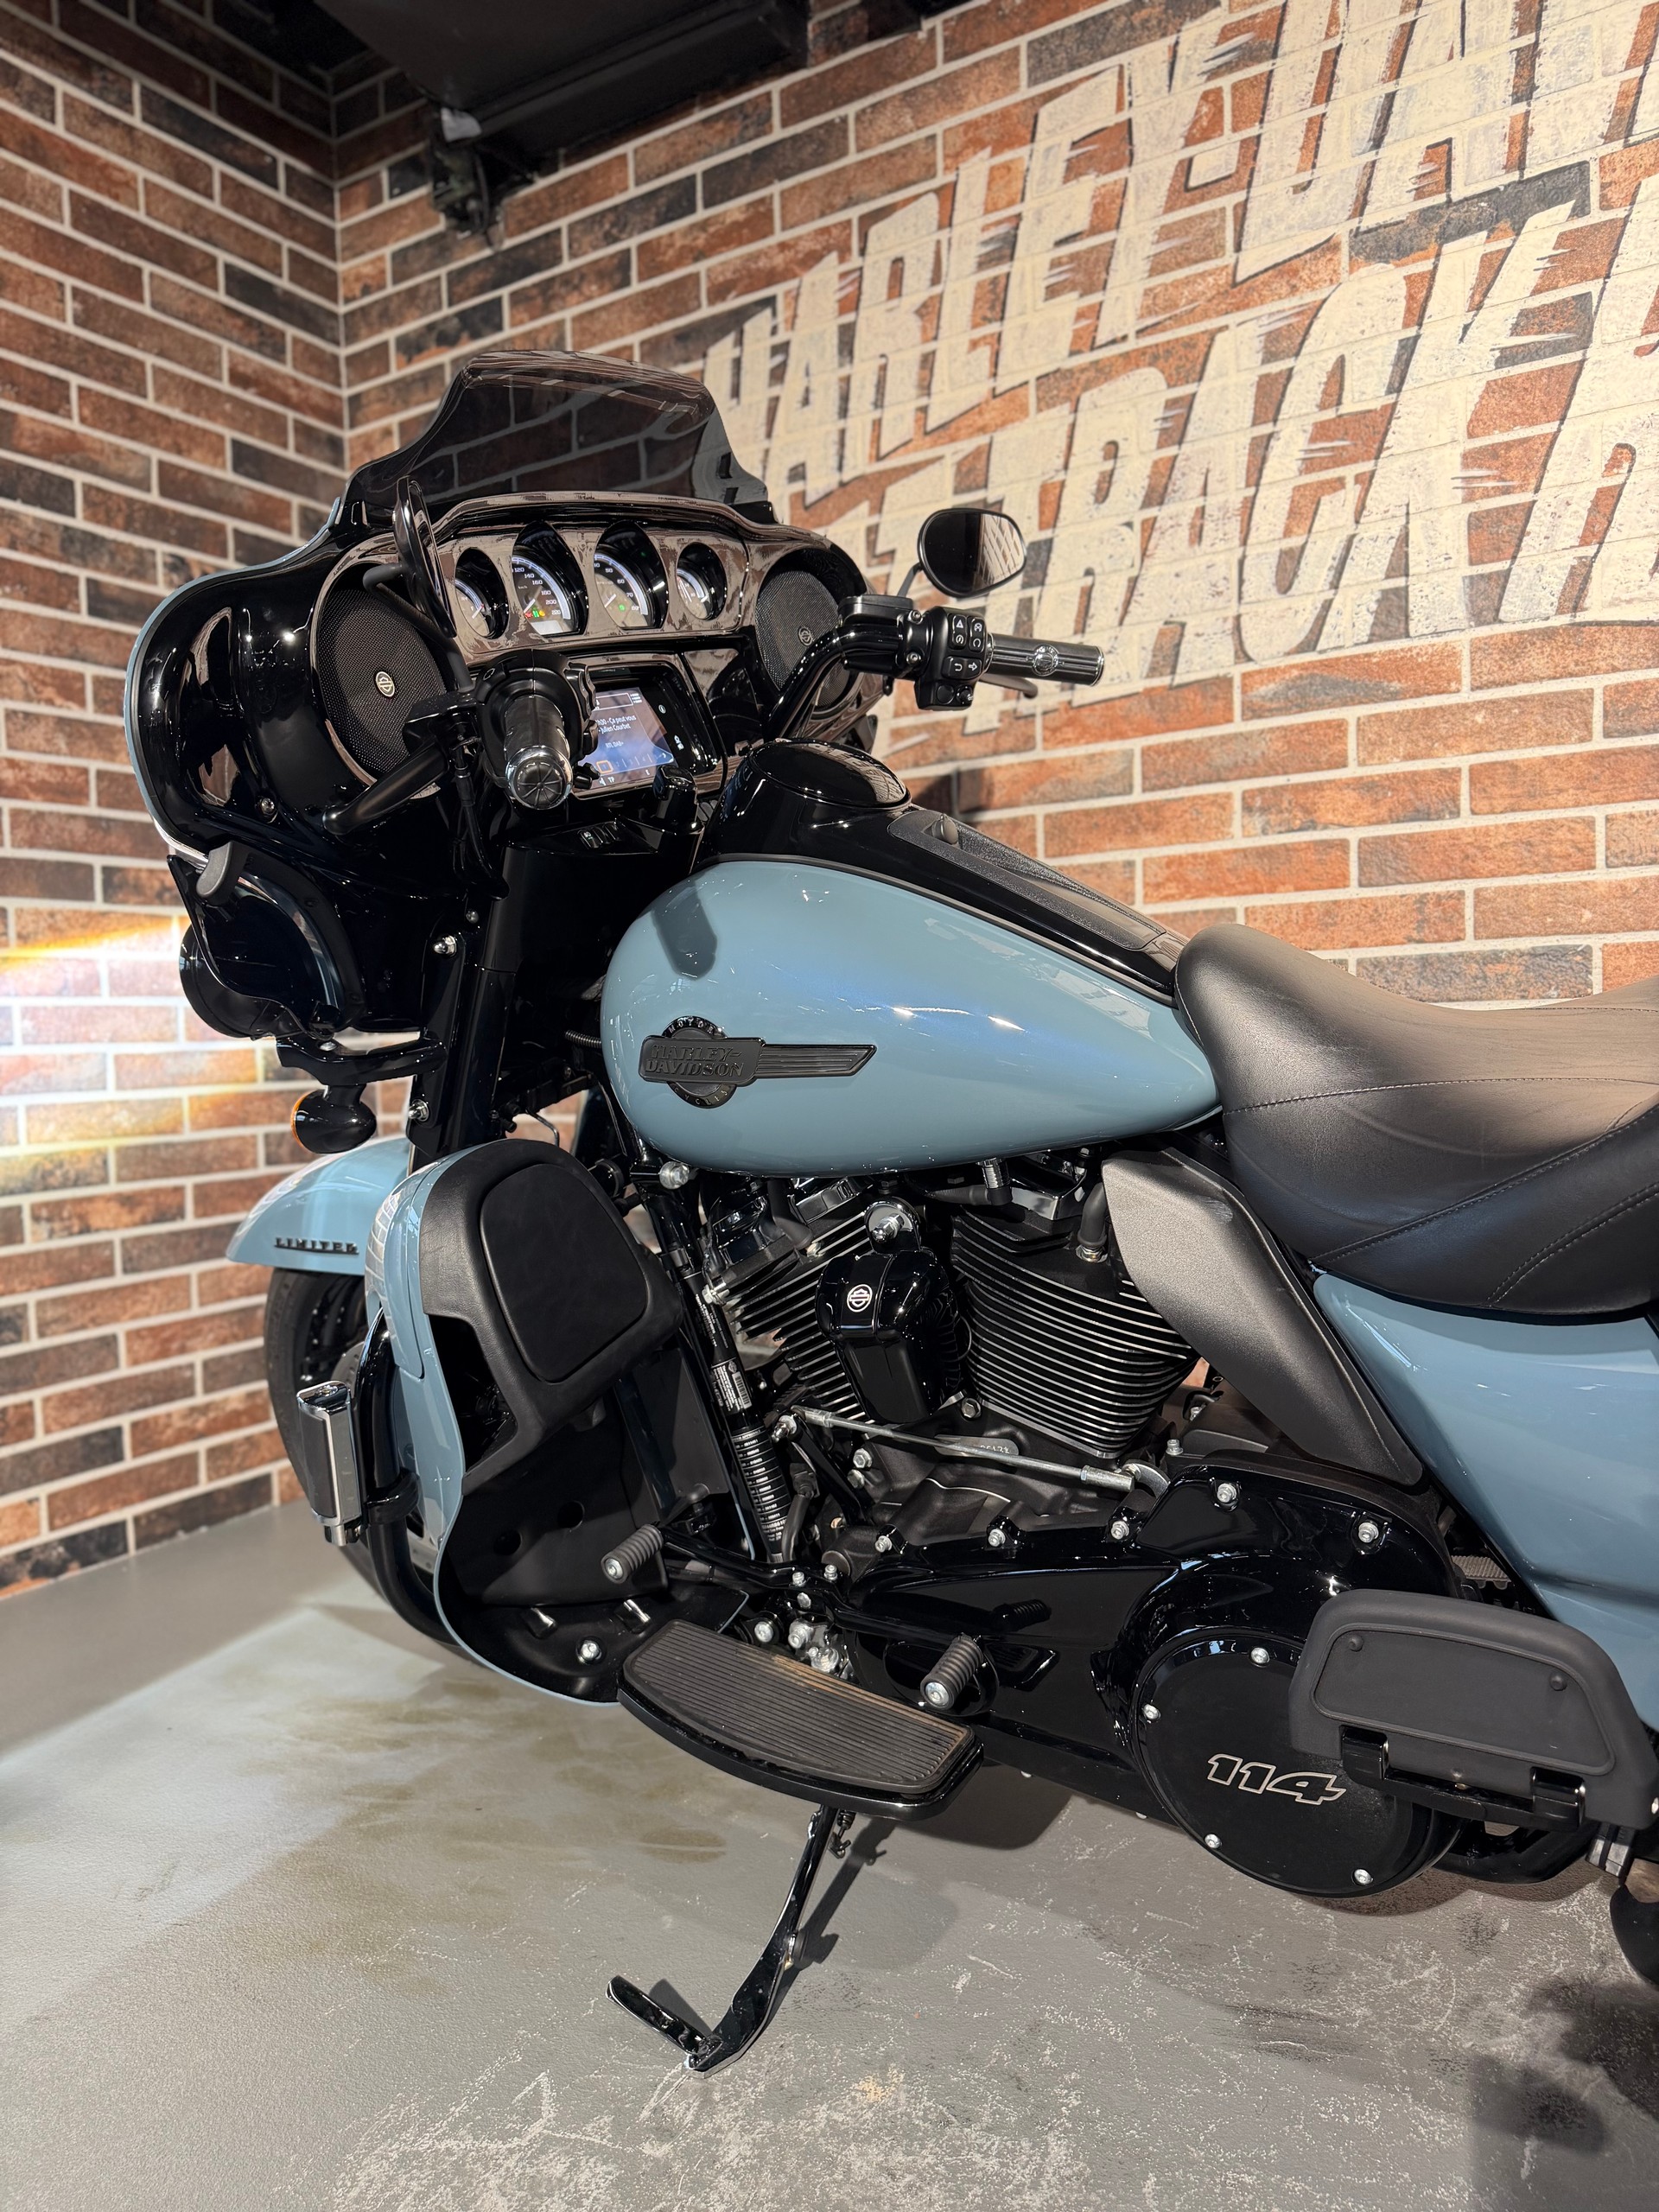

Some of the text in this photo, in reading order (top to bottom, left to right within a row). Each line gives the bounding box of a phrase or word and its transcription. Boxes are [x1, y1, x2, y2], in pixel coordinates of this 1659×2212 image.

[669, 1017, 715, 1034] MOTOR
[650, 1044, 741, 1060] HARLEY-
[645, 1059, 743, 1077] DAVIDSON
[674, 1085, 728, 1105] CYCLES
[275, 1236, 359, 1255] LIMITED
[1207, 1753, 1346, 1805] 114
